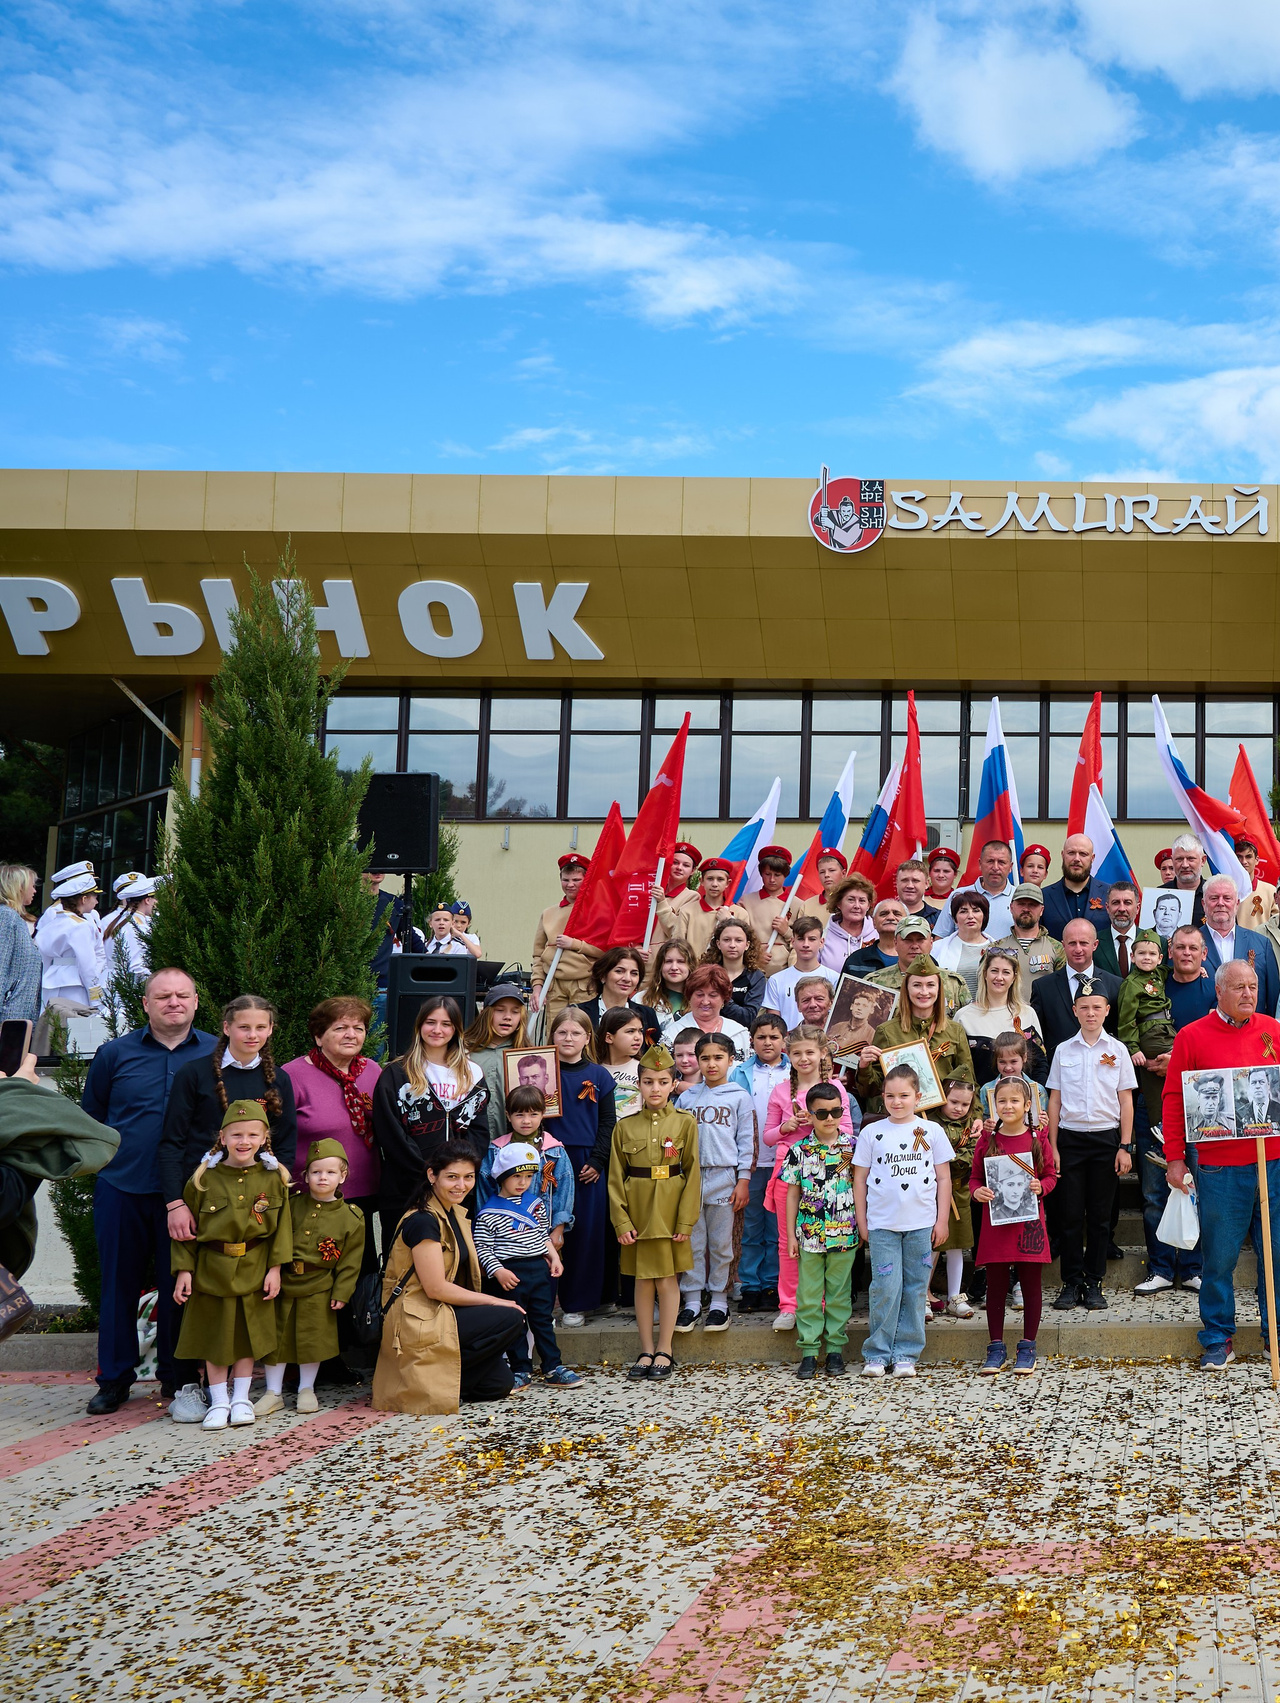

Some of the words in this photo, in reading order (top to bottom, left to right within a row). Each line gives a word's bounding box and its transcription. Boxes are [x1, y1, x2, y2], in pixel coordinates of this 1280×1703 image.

[860, 518, 884, 529] SHI
[0, 577, 605, 660] РЫНОК
[884, 1152, 922, 1164] Мамина
[890, 1164, 917, 1177] Доча
